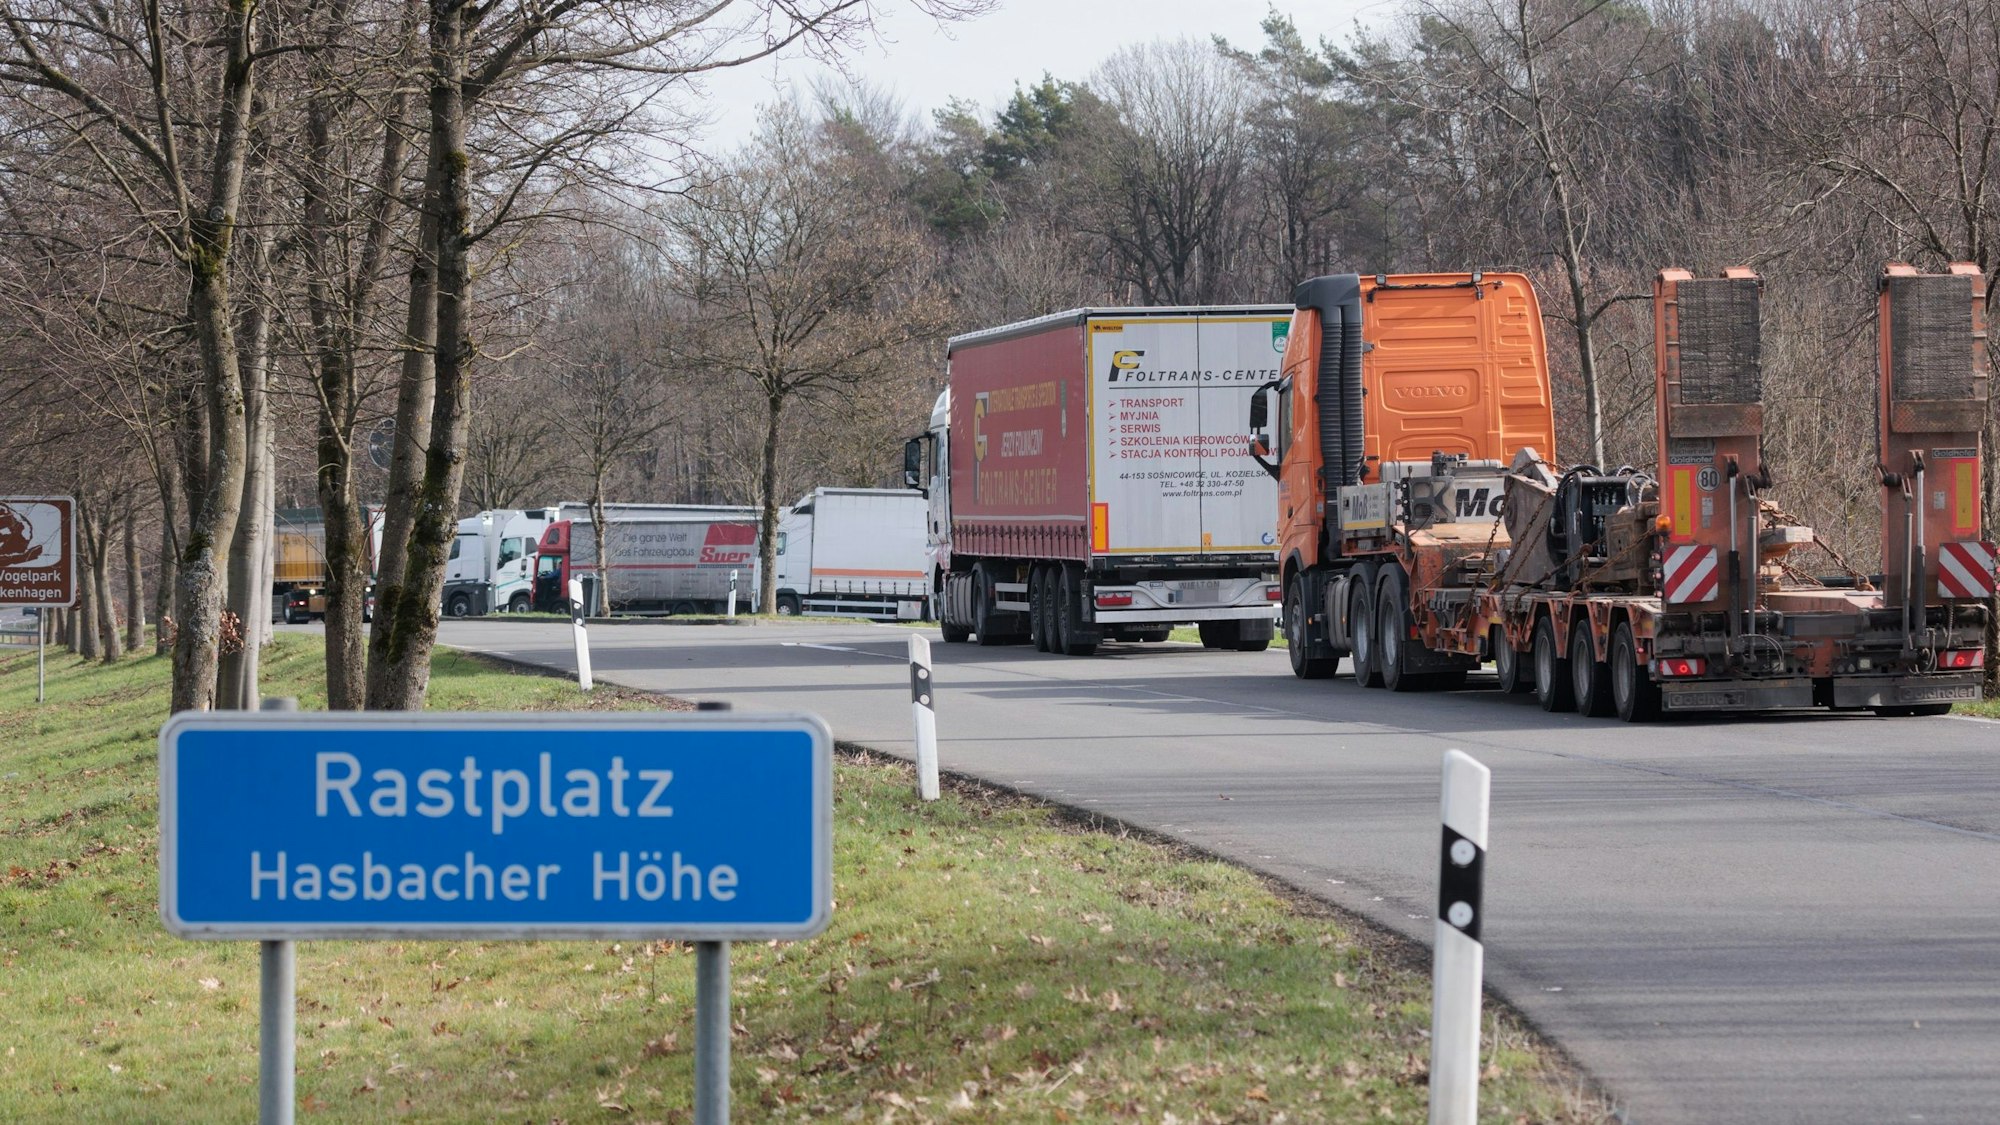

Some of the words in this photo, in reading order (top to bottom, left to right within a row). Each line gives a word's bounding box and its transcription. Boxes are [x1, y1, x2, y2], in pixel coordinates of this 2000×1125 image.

[1125, 369, 1279, 382] FOLTRANS-CENTE
[1393, 385, 1468, 399] VOLVO
[1120, 397, 1184, 408] TRANSPORT
[1120, 411, 1159, 421] MYJNIA
[1120, 424, 1161, 433] SERWIS
[1120, 436, 1180, 446] SZKOLENIA
[1183, 433, 1250, 445] KIEROWCÓW
[1121, 449, 1161, 459] STACJA
[1164, 448, 1217, 458] KONTROLI
[1120, 472, 1145, 480] 44-153
[1226, 470, 1270, 478] KOZIELSK
[1701, 471, 1717, 488] 80
[1160, 480, 1177, 488] TEL.
[1207, 480, 1245, 488] 330-47-50
[1162, 489, 1243, 498] www.foltrans.com.pl
[1456, 488, 1505, 517] Mo
[623, 533, 637, 543] Die
[639, 534, 667, 545] ganze
[669, 532, 687, 542] Welt
[633, 546, 695, 559] Fahrzeugbaus
[699, 547, 751, 563] Suer
[1178, 580, 1220, 591] WIELTON
[0, 586, 62, 600] kenhagen
[315, 751, 674, 834] Rastplatz
[250, 851, 561, 901] Hasbacher
[592, 851, 740, 901] Höhe
